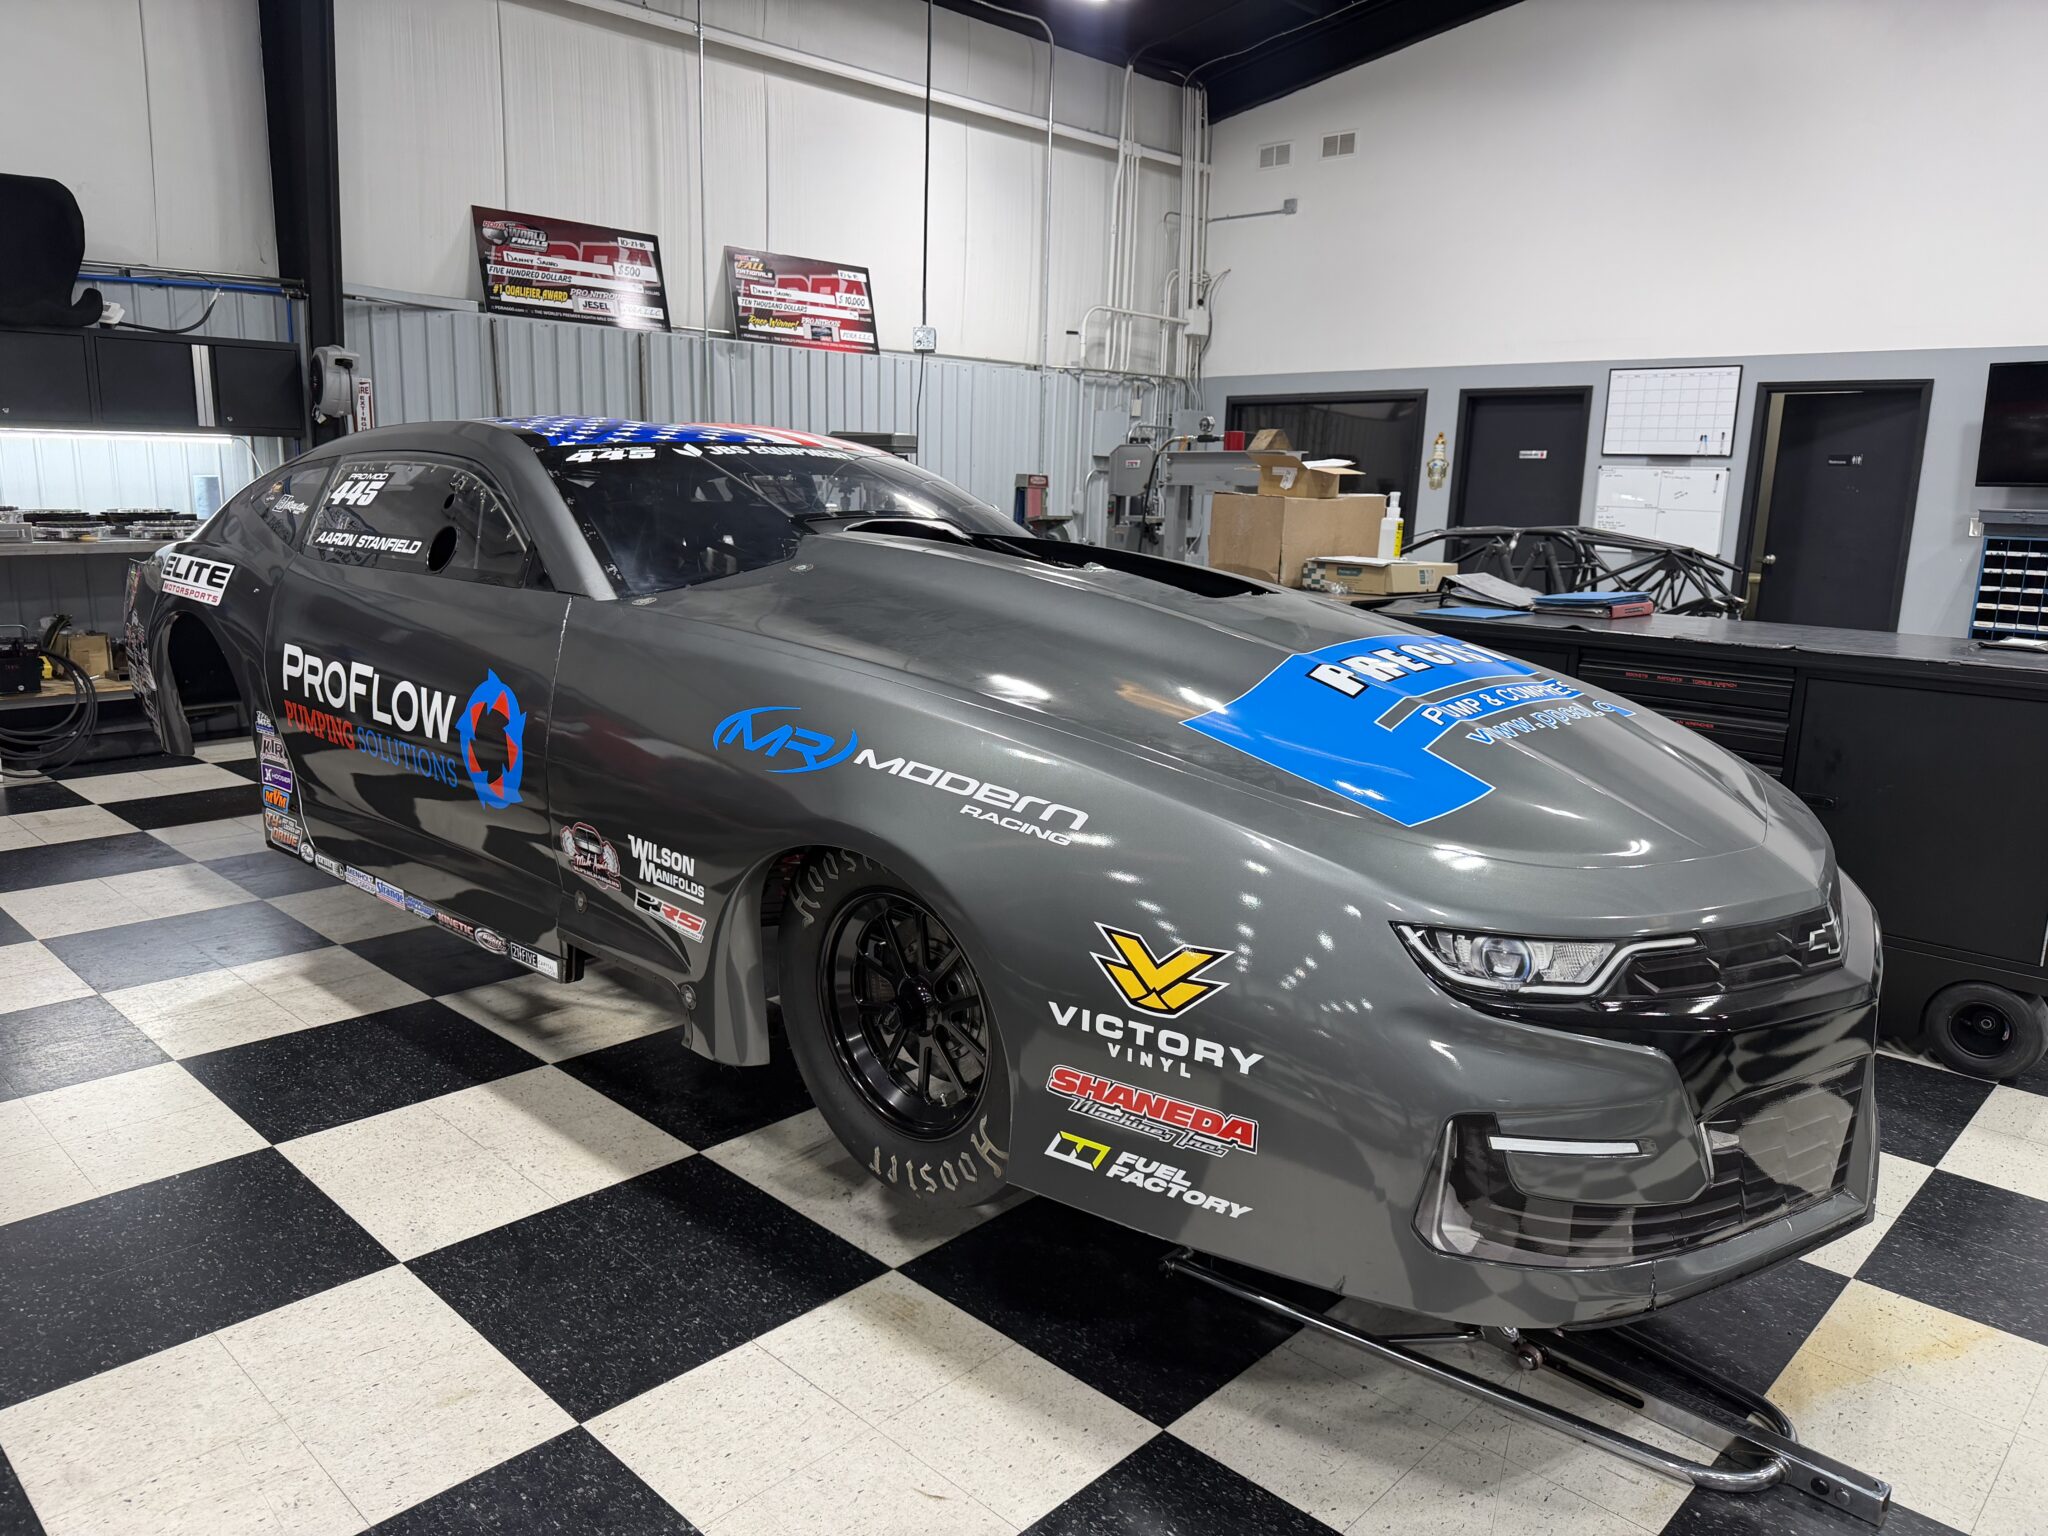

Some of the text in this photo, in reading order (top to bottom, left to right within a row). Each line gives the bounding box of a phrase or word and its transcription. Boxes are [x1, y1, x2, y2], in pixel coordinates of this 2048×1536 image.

[510, 229, 546, 241] WORLD
[511, 237, 548, 247] FINALS
[506, 252, 533, 263] DANNY
[737, 261, 764, 271] FALL
[489, 266, 572, 283] FIVE HUNDRED DOLLARS
[493, 284, 568, 302] #1 QUALIFIER AWARD
[570, 288, 588, 298] PRO
[583, 300, 609, 310] JESEL
[741, 298, 807, 312] TEN THOUSAND DOLLARS
[565, 449, 656, 463] 445
[704, 446, 750, 455] JBS
[330, 481, 386, 506] 445
[315, 531, 422, 554] AARON STANFIELD
[163, 556, 231, 589] ELITE
[163, 582, 218, 604] MOTORSPORTS
[1421, 701, 1482, 725] PUMP
[1482, 692, 1505, 706] &
[284, 699, 355, 750] PUMPING
[357, 726, 459, 788] SOLUTIONS
[959, 804, 1072, 846] RACING
[628, 834, 695, 877] WILSON
[639, 858, 705, 900] MANIFOLDS
[437, 912, 474, 936] KINETIC
[1048, 1001, 1264, 1075] VICTORY
[1107, 1042, 1191, 1078] VINYL
[1050, 1067, 1256, 1150] SHANEDA
[1115, 1152, 1191, 1187] FUEL
[1106, 1164, 1253, 1219] FACTORY
